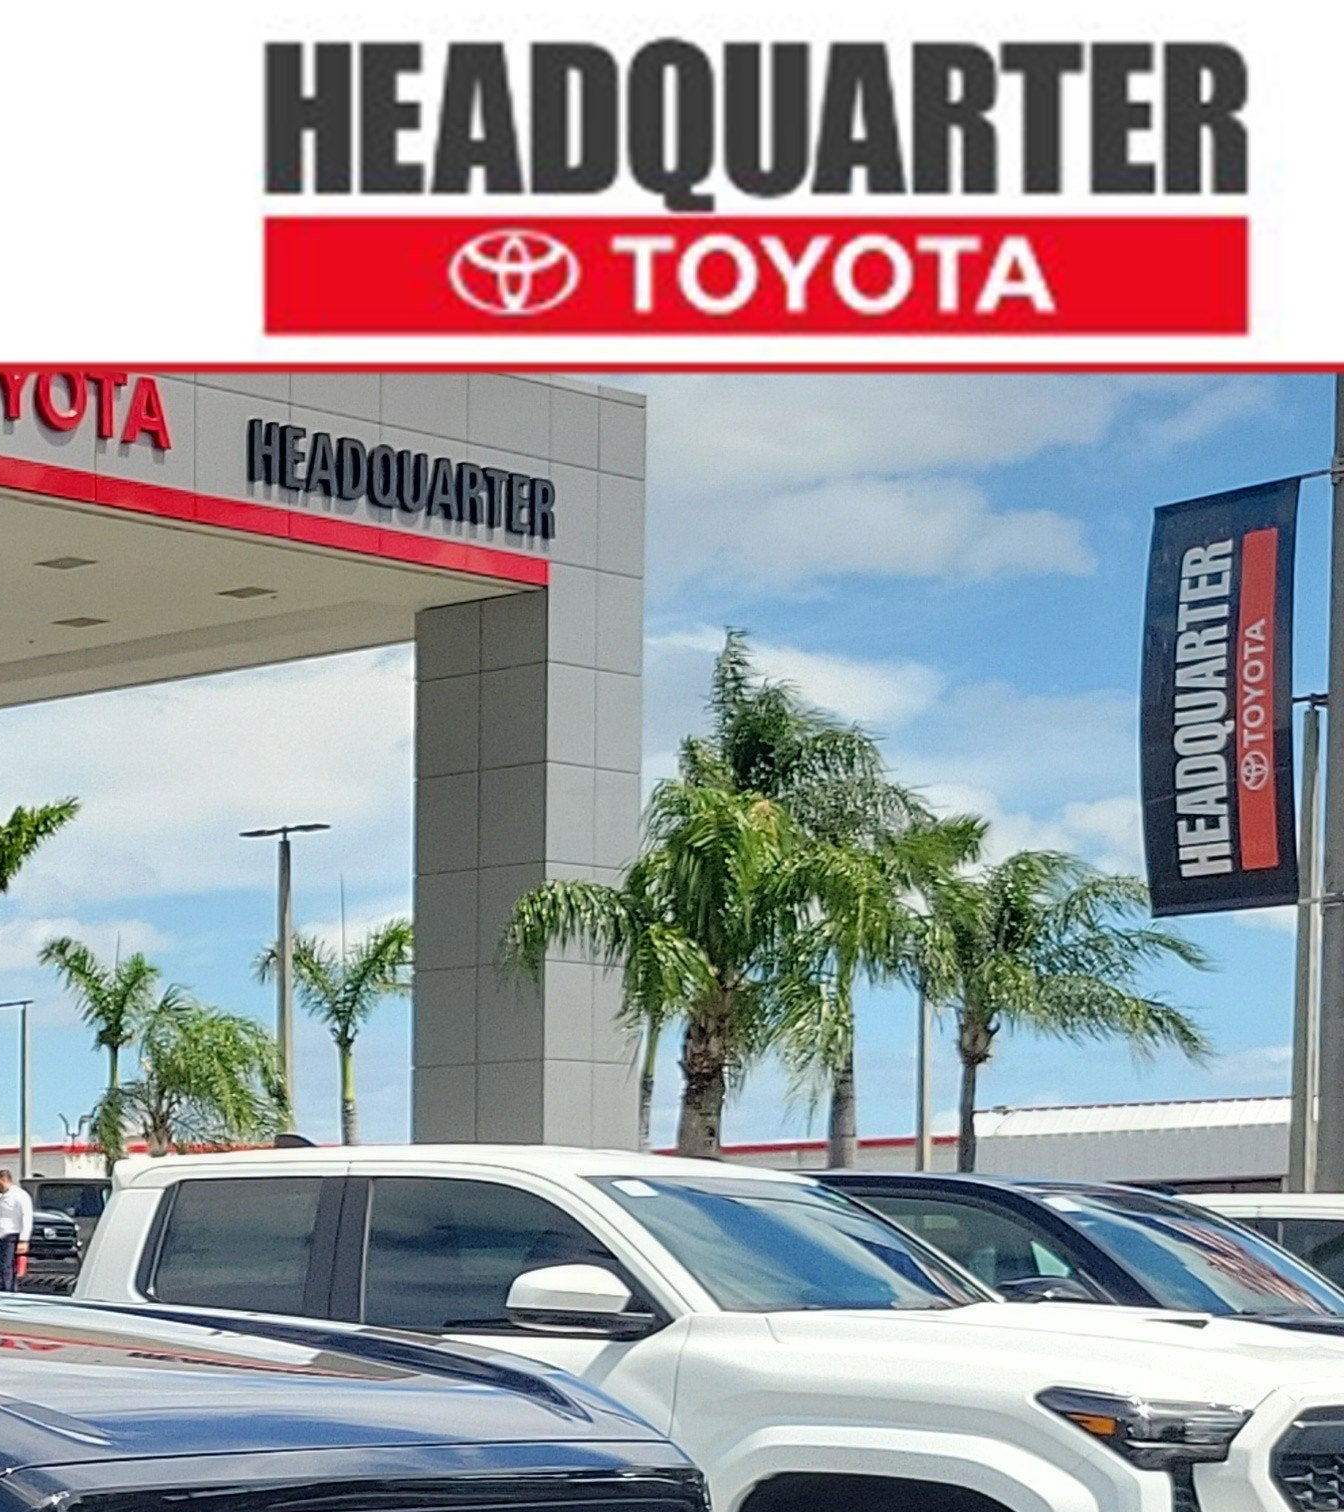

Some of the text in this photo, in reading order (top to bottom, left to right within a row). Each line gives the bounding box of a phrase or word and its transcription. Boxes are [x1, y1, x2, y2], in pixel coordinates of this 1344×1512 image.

[247, 418, 556, 540] HEADQUARTER
[1174, 538, 1234, 878] HEADQUARTER
[1242, 618, 1267, 749] TOYOTA
